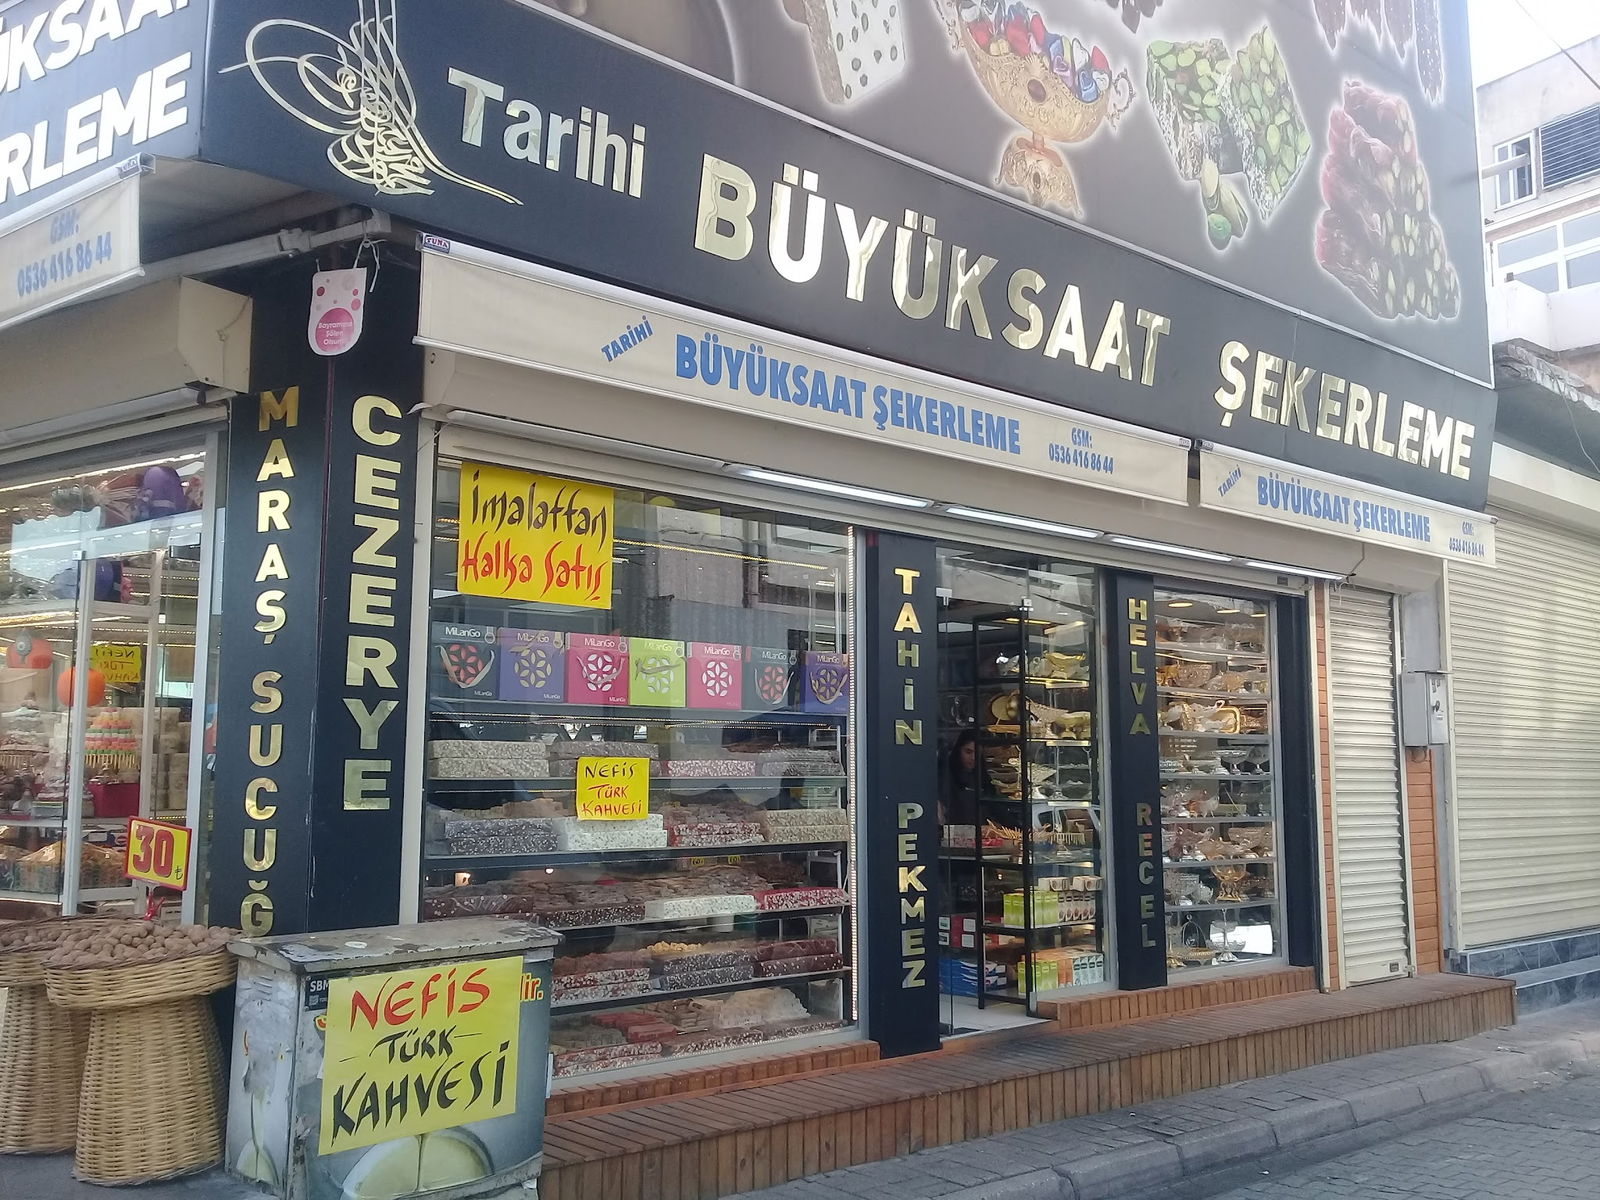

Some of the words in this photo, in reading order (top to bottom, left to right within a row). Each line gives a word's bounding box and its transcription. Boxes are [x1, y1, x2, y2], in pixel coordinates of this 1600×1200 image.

[448, 66, 647, 199] Tarihi
[17, 259, 48, 297] 0536
[50, 247, 73, 283] 416
[76, 239, 93, 273] 86
[95, 231, 113, 264] 44
[601, 315, 654, 363] TARİHİ
[694, 153, 1171, 386] BÜYÜKSAAT
[1213, 340, 1476, 480] ŞEKERLEME
[676, 331, 867, 419] BÜYÜKSAAT
[872, 384, 1021, 455] ŞEKERLEME
[1048, 443, 1071, 465] 0536
[1072, 452, 1089, 469] 416
[1090, 452, 1101, 472] 86
[1102, 455, 1114, 474] 44
[1071, 427, 1093, 448] GSM:
[253, 391, 298, 645] MARAŞ
[1257, 471, 1351, 525] BÜYÜKSAAT
[1352, 499, 1431, 542] ŞEKERLEME
[461, 530, 533, 595] Halka
[343, 395, 403, 811] CEZERYE
[1128, 598, 1151, 735] HELVA
[241, 671, 285, 937] SUCUĞ
[581, 800, 642, 817] KAHVESİ
[588, 784, 629, 799] TÜRK
[133, 824, 175, 878] 30
[897, 803, 928, 989] PEKMEZ
[369, 1025, 457, 1064] TÜRK
[331, 1040, 511, 1148] KAHVESİ
